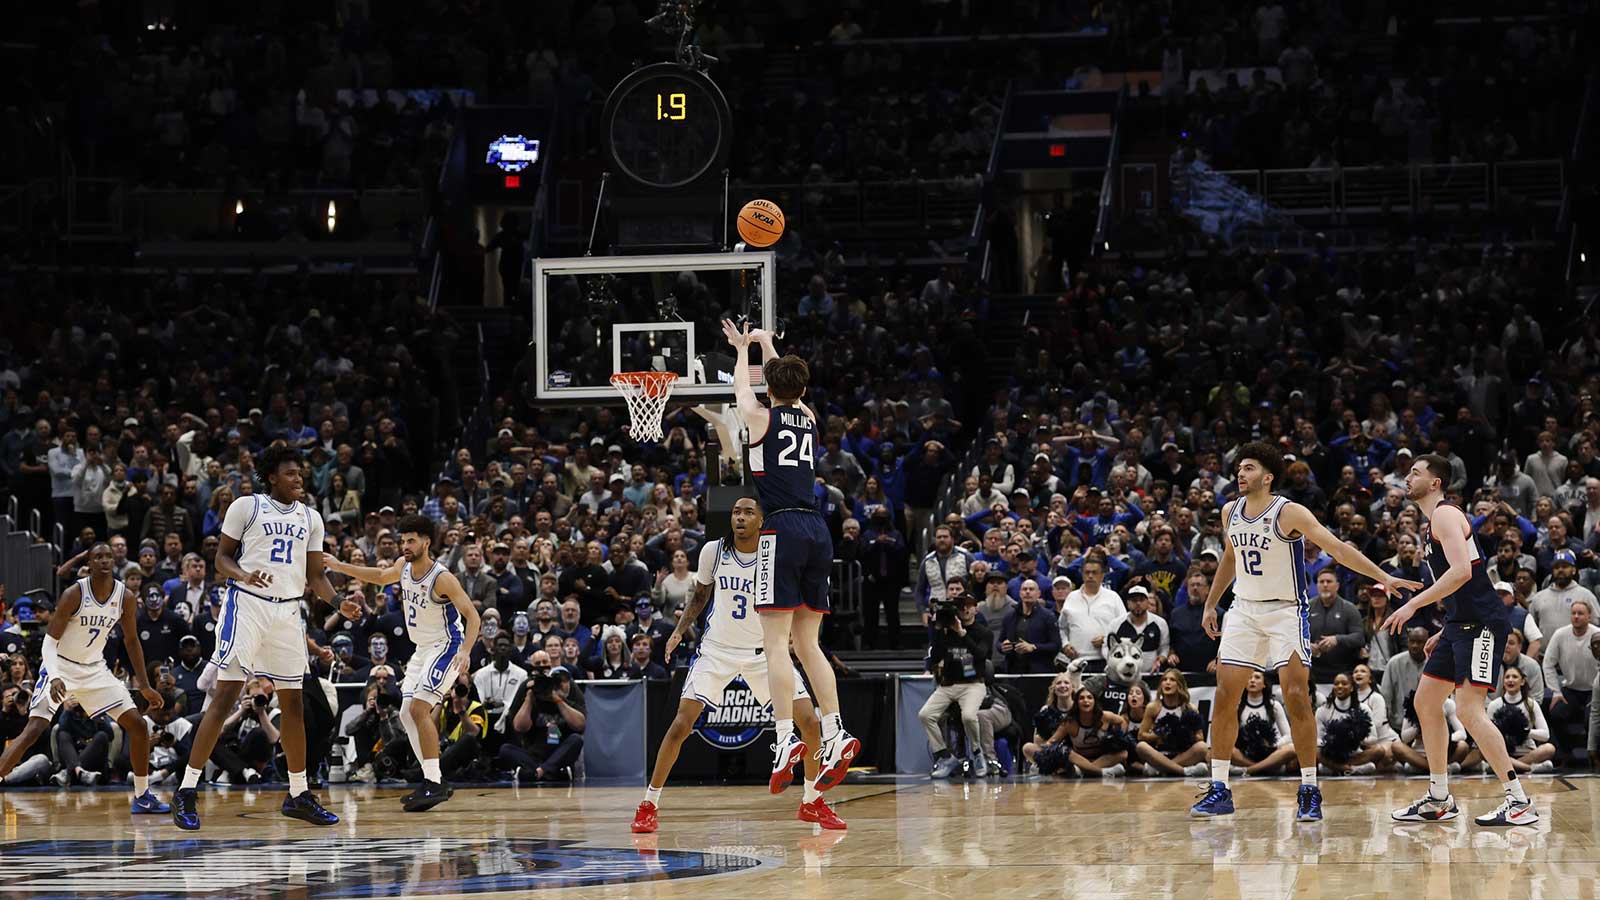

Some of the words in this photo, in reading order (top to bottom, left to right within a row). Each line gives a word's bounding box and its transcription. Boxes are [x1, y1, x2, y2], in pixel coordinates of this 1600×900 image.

[657, 93, 686, 120] 1.9
[752, 211, 775, 226] NCAA
[780, 412, 812, 430] MULLINS
[778, 429, 814, 470] 24
[262, 522, 307, 541] DUKE
[1231, 533, 1272, 551] DUKE
[270, 538, 294, 565] 21
[760, 540, 770, 602] HUSKIES
[1241, 549, 1263, 576] 12
[719, 575, 756, 595] DUK
[402, 588, 427, 609] DUKE
[731, 594, 748, 620] 3
[80, 615, 116, 629] DUKE
[408, 605, 417, 628] 2
[86, 627, 101, 648] 7
[1479, 629, 1491, 680] HUSKIE
[720, 689, 755, 706] RCH
[1104, 690, 1127, 700] UCO
[719, 735, 736, 743] ELITE
